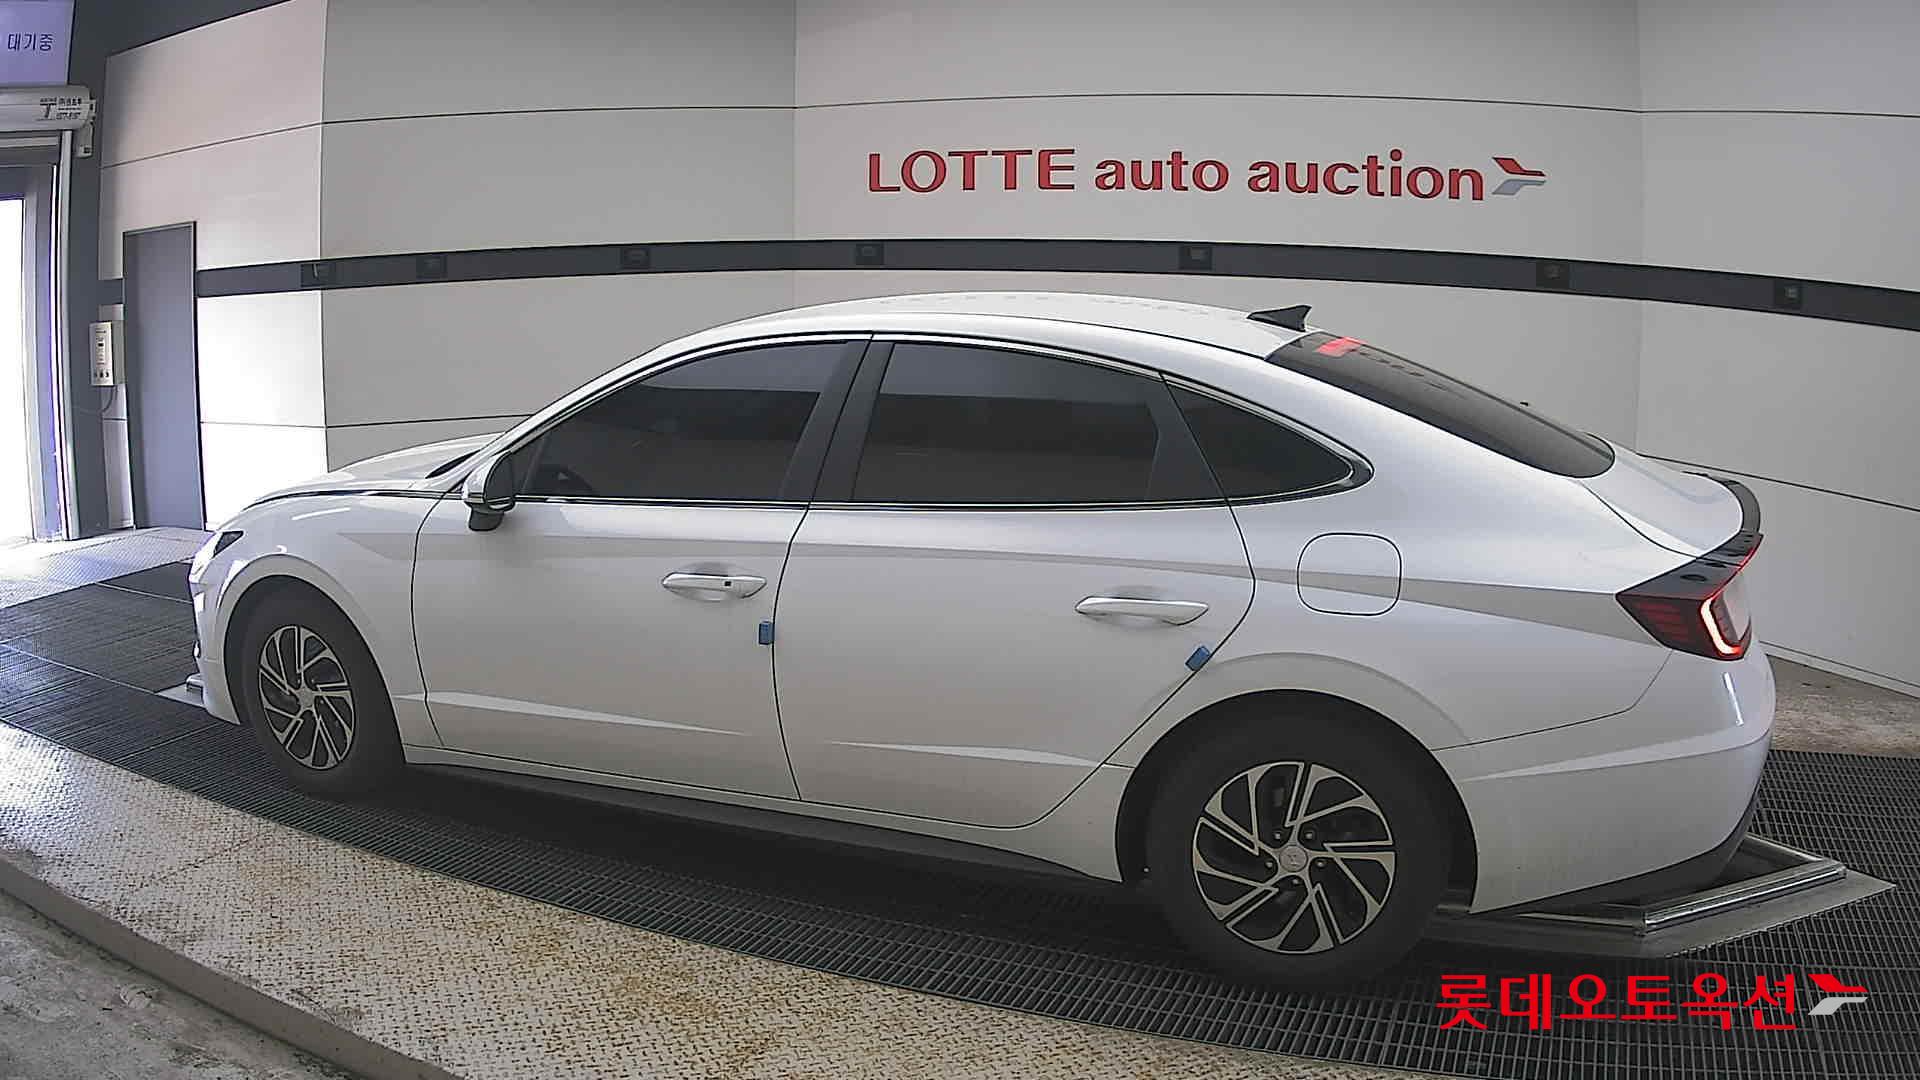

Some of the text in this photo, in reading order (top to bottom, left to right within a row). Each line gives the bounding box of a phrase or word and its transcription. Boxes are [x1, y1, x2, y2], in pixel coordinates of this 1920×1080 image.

[8, 33, 54, 52] 대기중
[868, 149, 1484, 200] LOTTE auto auction
